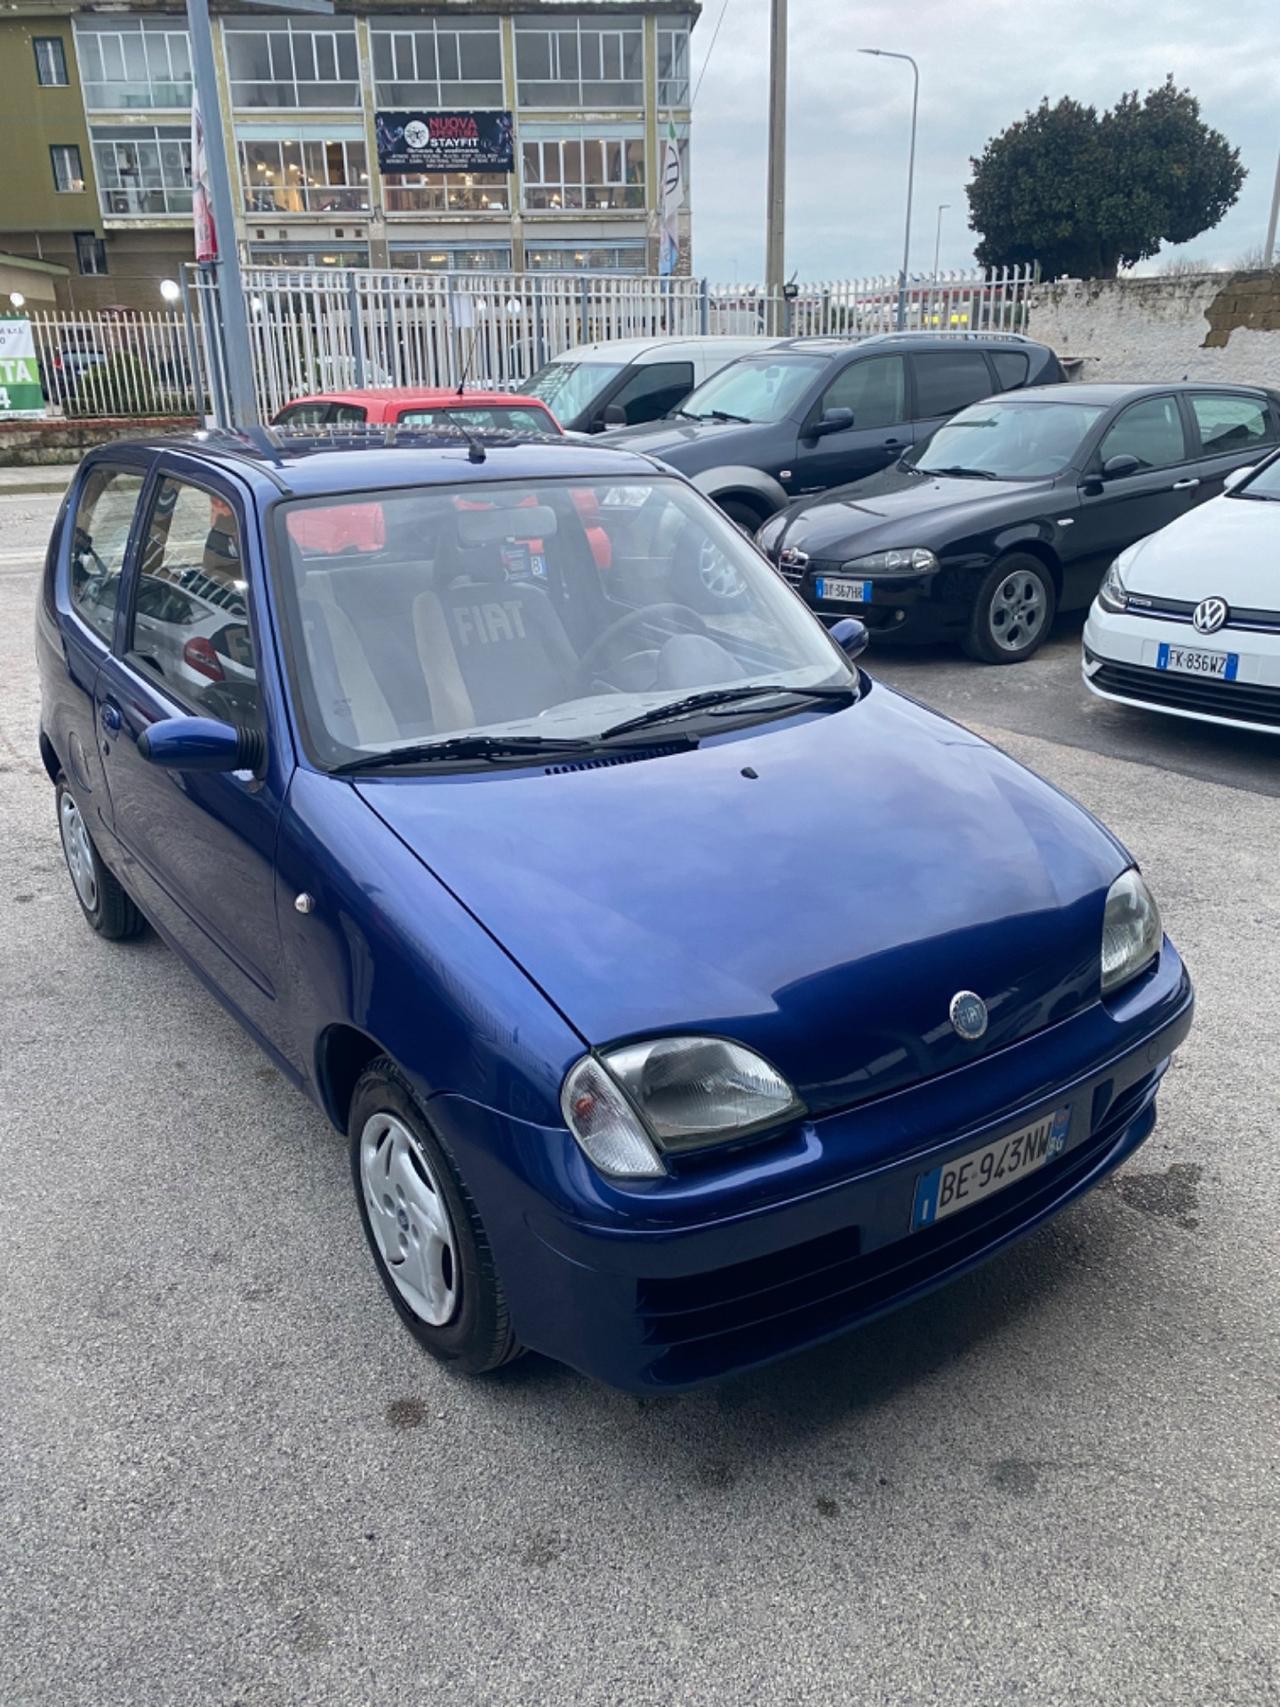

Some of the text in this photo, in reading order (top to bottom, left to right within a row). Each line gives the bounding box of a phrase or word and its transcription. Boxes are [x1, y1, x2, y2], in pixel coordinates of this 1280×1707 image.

[429, 117, 477, 129] NUOVA
[430, 138, 480, 147] STAYFIT
[0, 359, 33, 383] TA
[453, 600, 527, 645] FIAT
